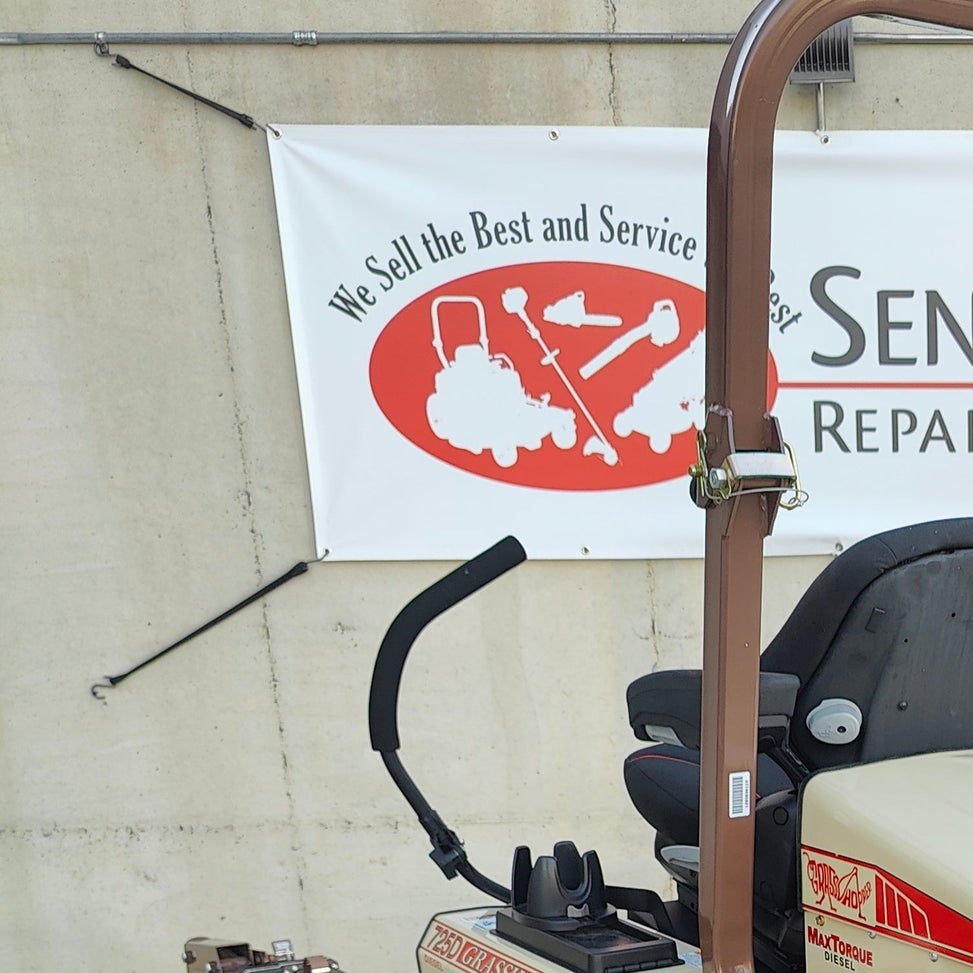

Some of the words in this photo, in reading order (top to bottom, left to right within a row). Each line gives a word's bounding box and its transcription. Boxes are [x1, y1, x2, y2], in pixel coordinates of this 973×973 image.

[328, 284, 377, 324] We
[364, 240, 422, 292] Sell
[422, 222, 468, 264] the
[469, 210, 535, 250] Best
[542, 203, 590, 242] and
[599, 204, 697, 261] Service
[768, 269, 803, 334] est
[426, 924, 464, 960] 725D
[807, 926, 873, 968] MAXTORQUE
[824, 951, 856, 972] DIESEL
